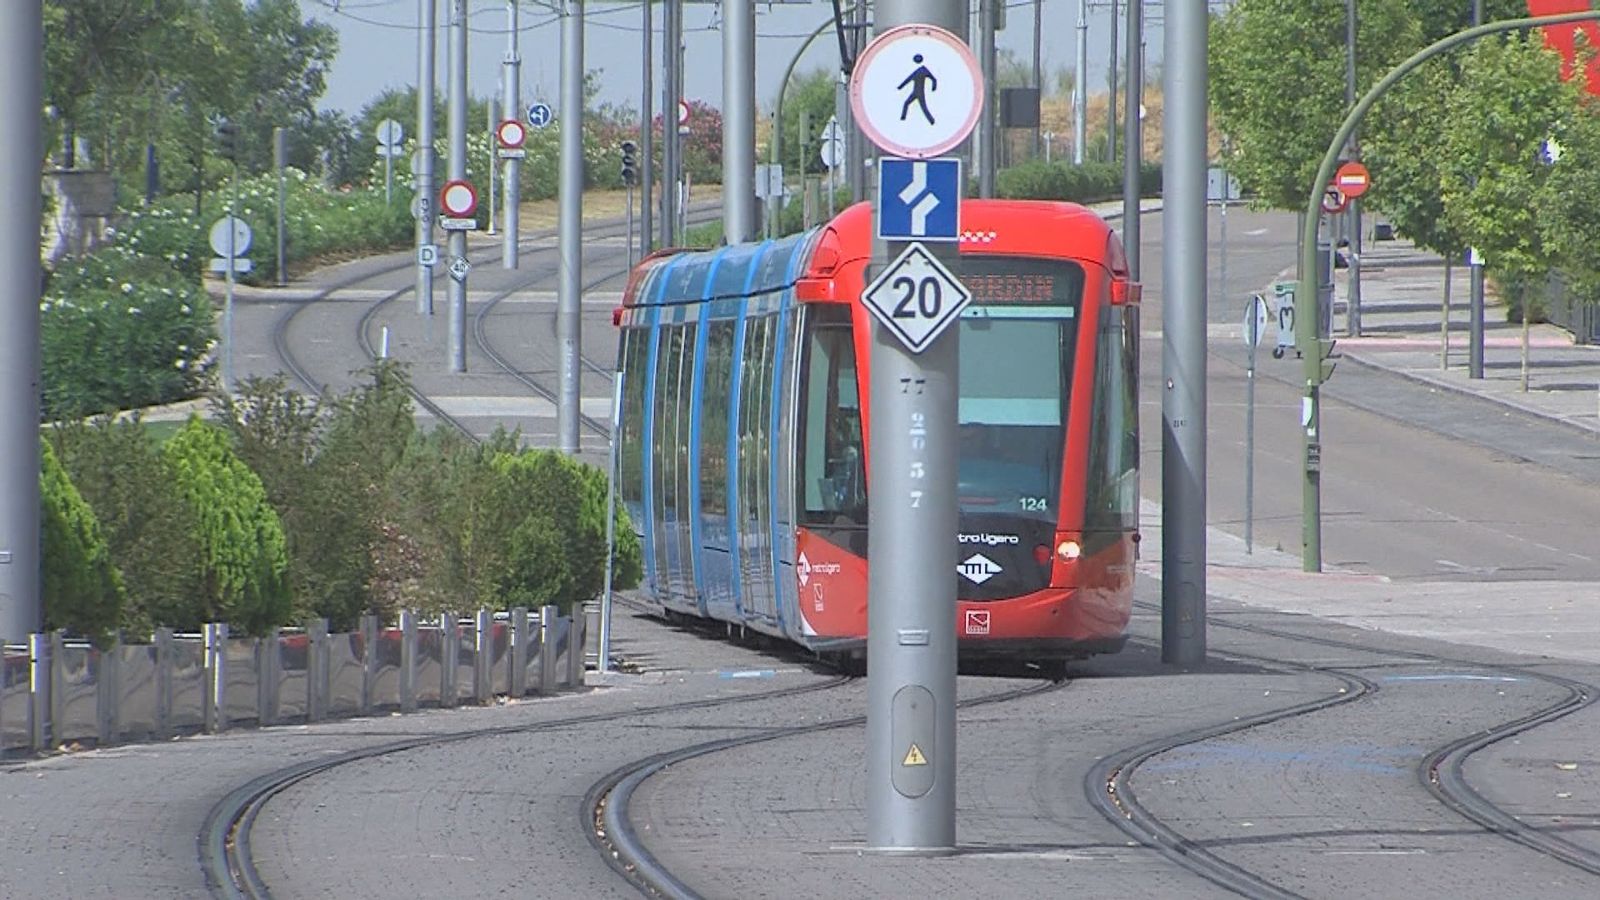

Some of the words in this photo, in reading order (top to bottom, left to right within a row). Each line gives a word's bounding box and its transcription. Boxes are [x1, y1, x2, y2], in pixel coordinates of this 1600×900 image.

[422, 248, 434, 261] D
[893, 276, 942, 319] 20
[1019, 497, 1047, 511] 124
